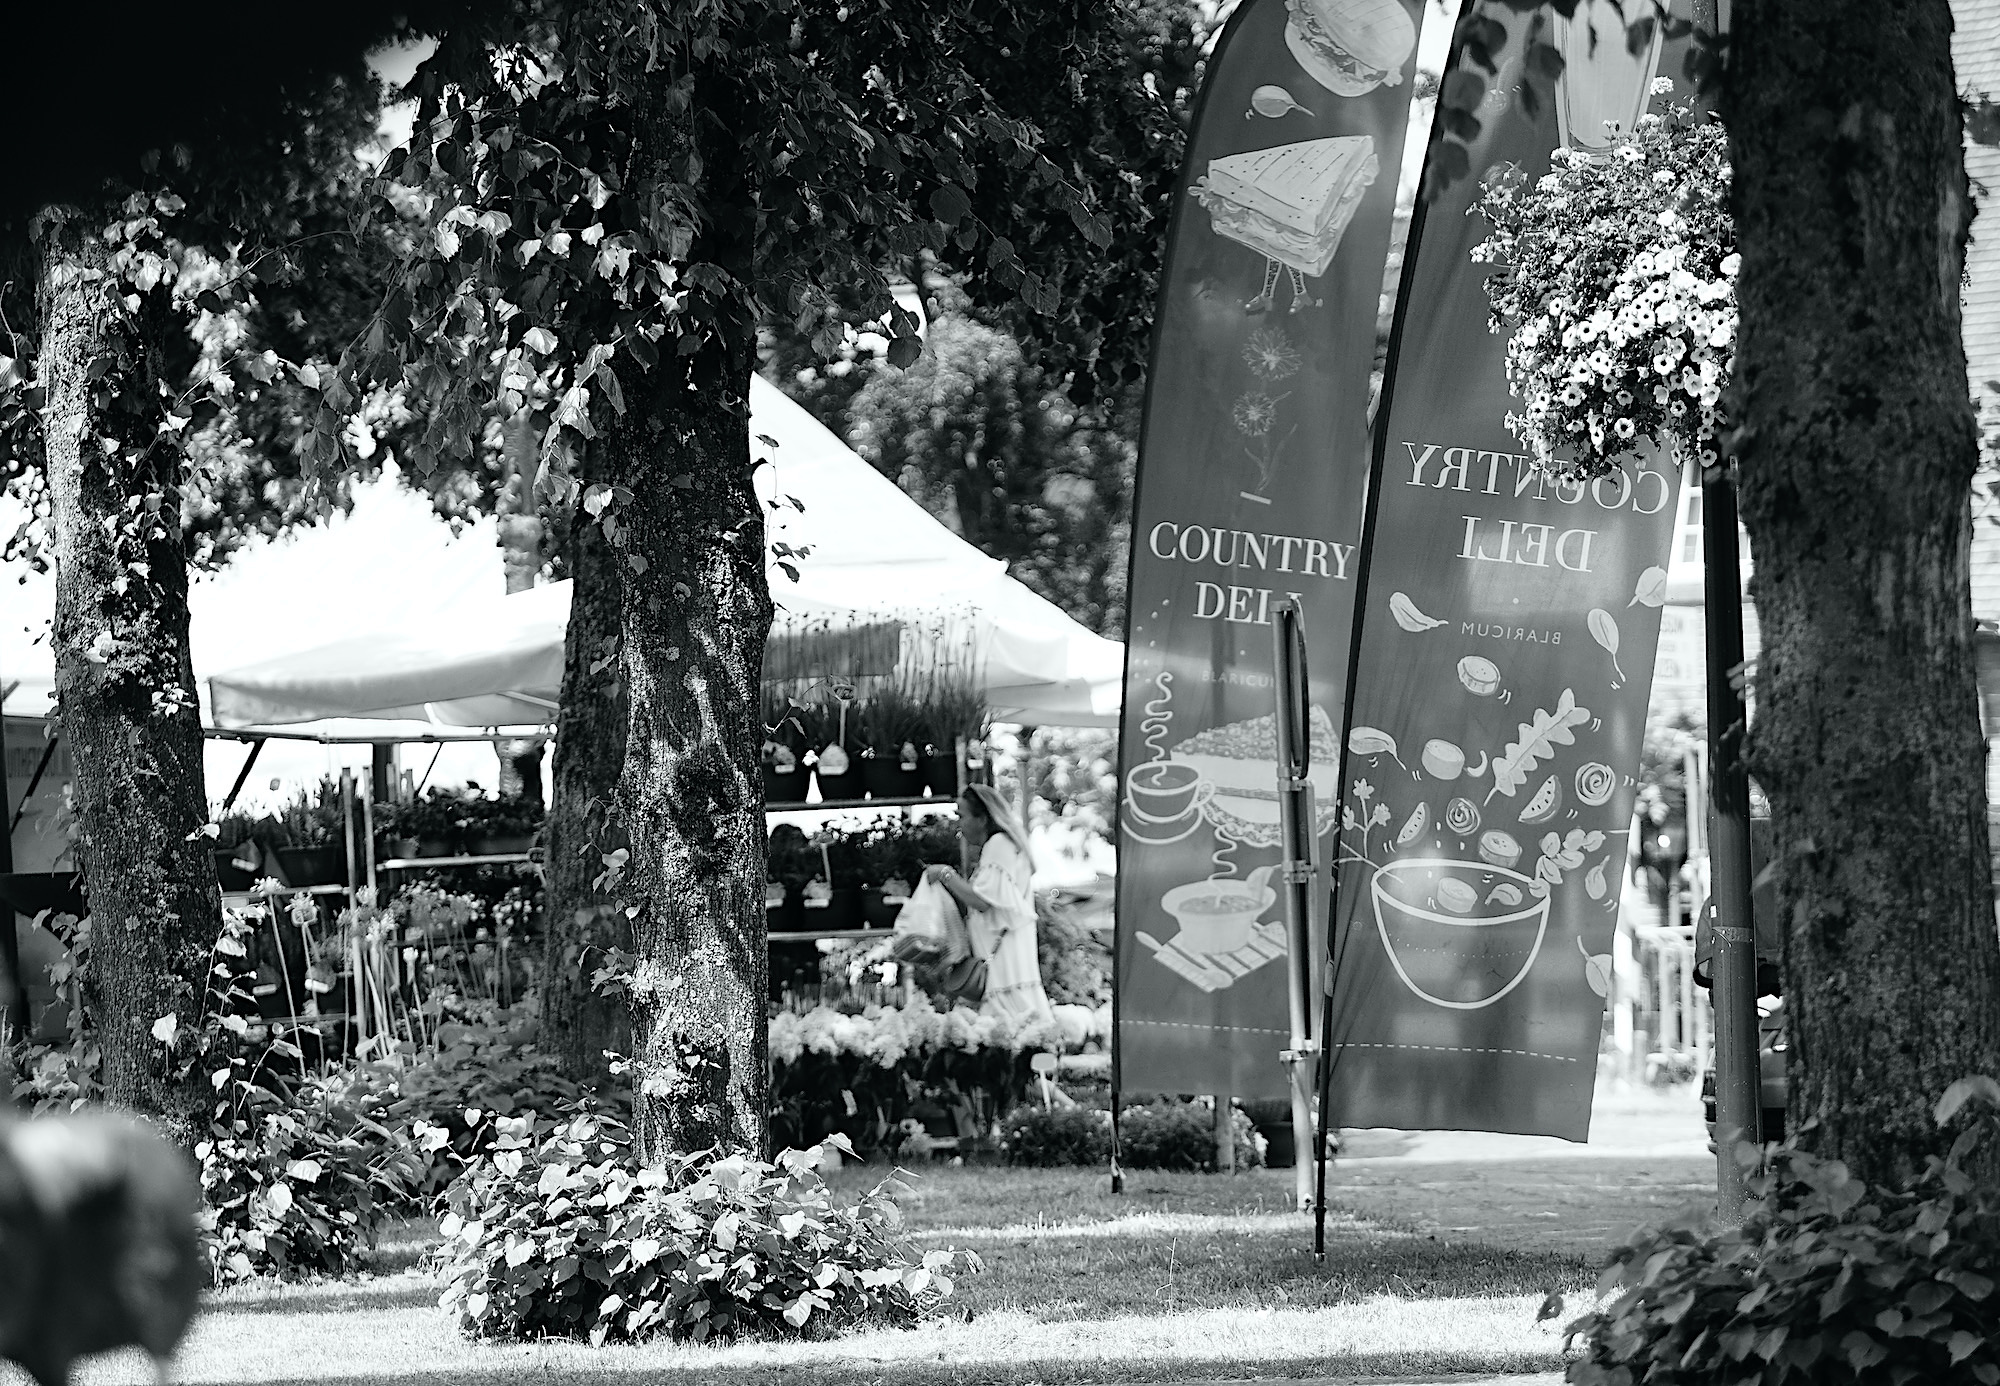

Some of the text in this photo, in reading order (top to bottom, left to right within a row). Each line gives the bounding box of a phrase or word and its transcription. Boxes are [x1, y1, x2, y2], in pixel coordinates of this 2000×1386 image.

[1149, 521, 1356, 580] COUNTRY
[1192, 581, 1303, 625] DEL
[1201, 670, 1275, 688] BLARICU
